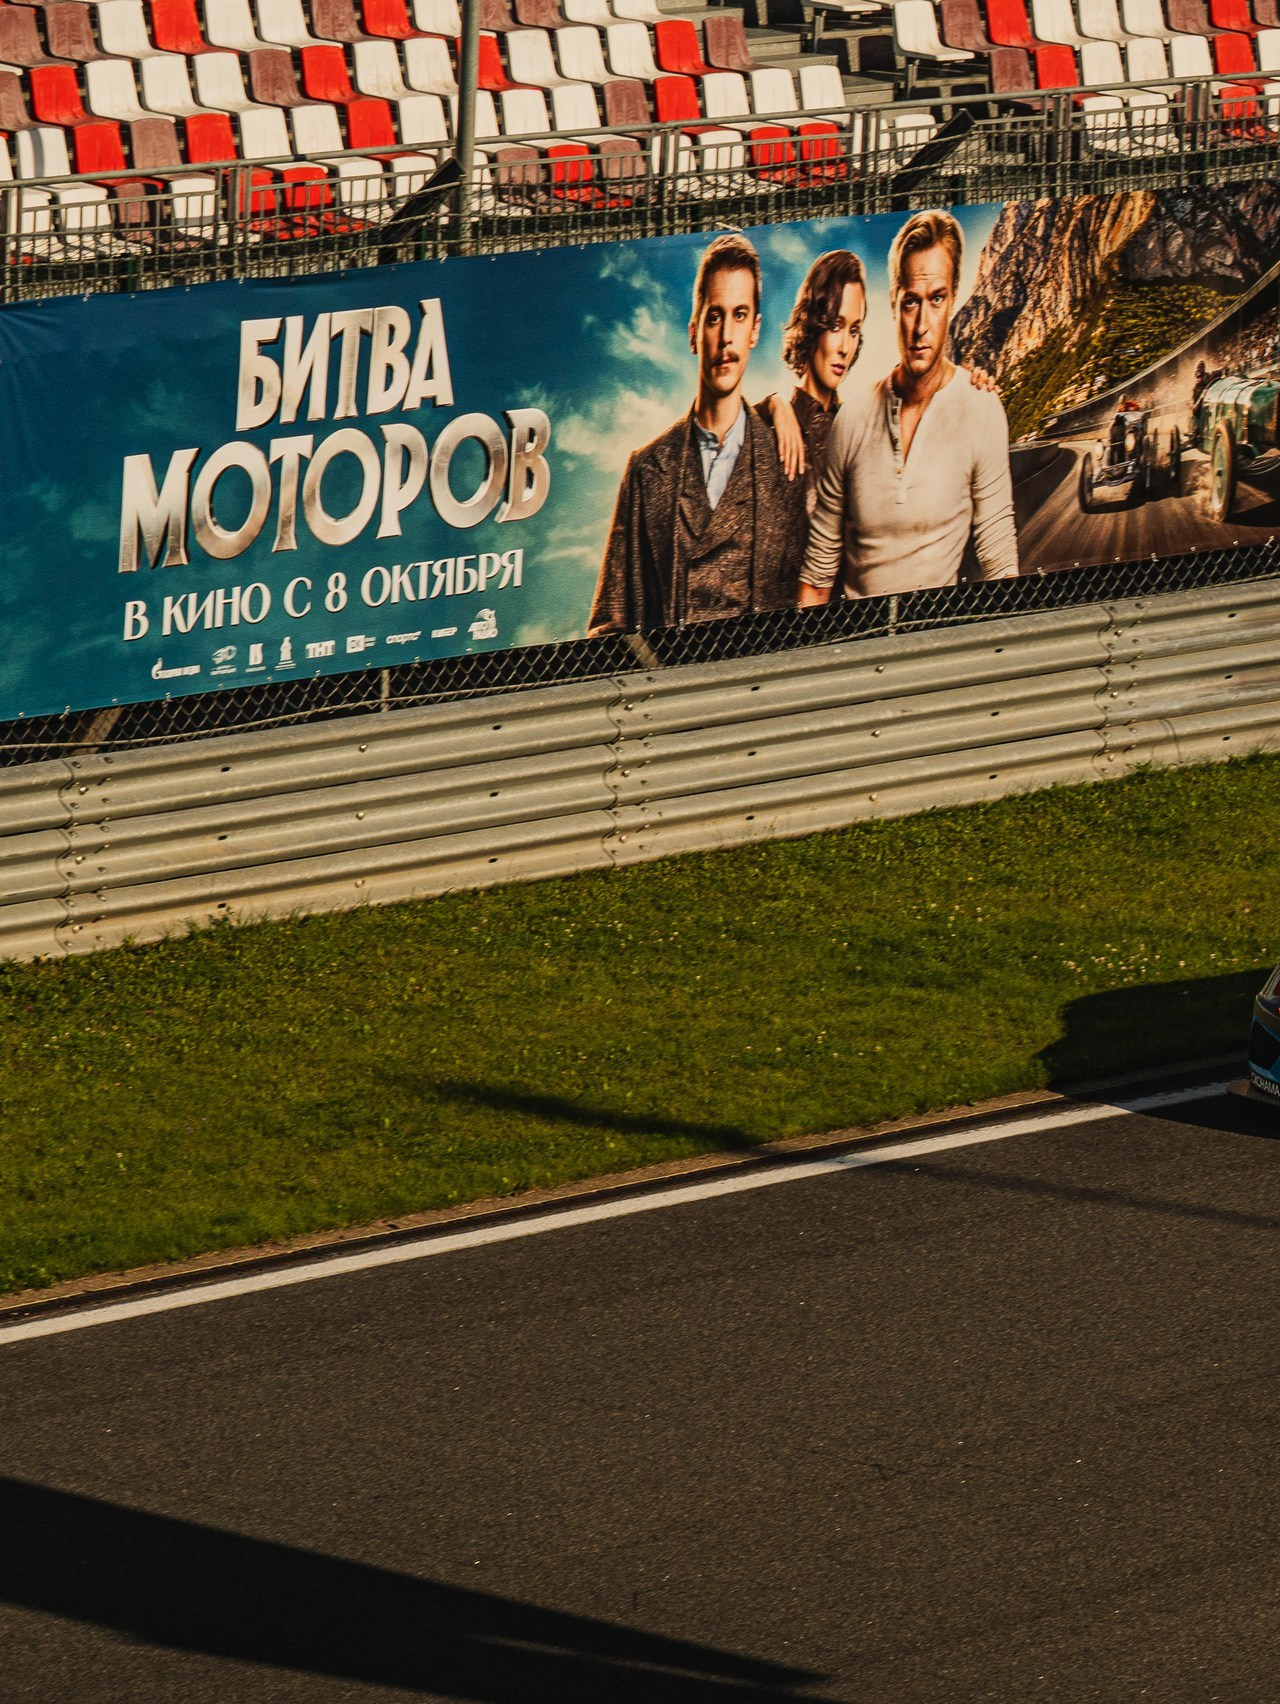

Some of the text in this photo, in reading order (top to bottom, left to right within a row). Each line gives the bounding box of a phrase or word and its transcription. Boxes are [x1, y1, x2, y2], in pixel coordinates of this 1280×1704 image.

[235, 297, 455, 431] БИТВА
[117, 407, 551, 574] МОТОРОВ
[123, 548, 524, 641] В КИНО С 8 ОКТЯБРЯ
